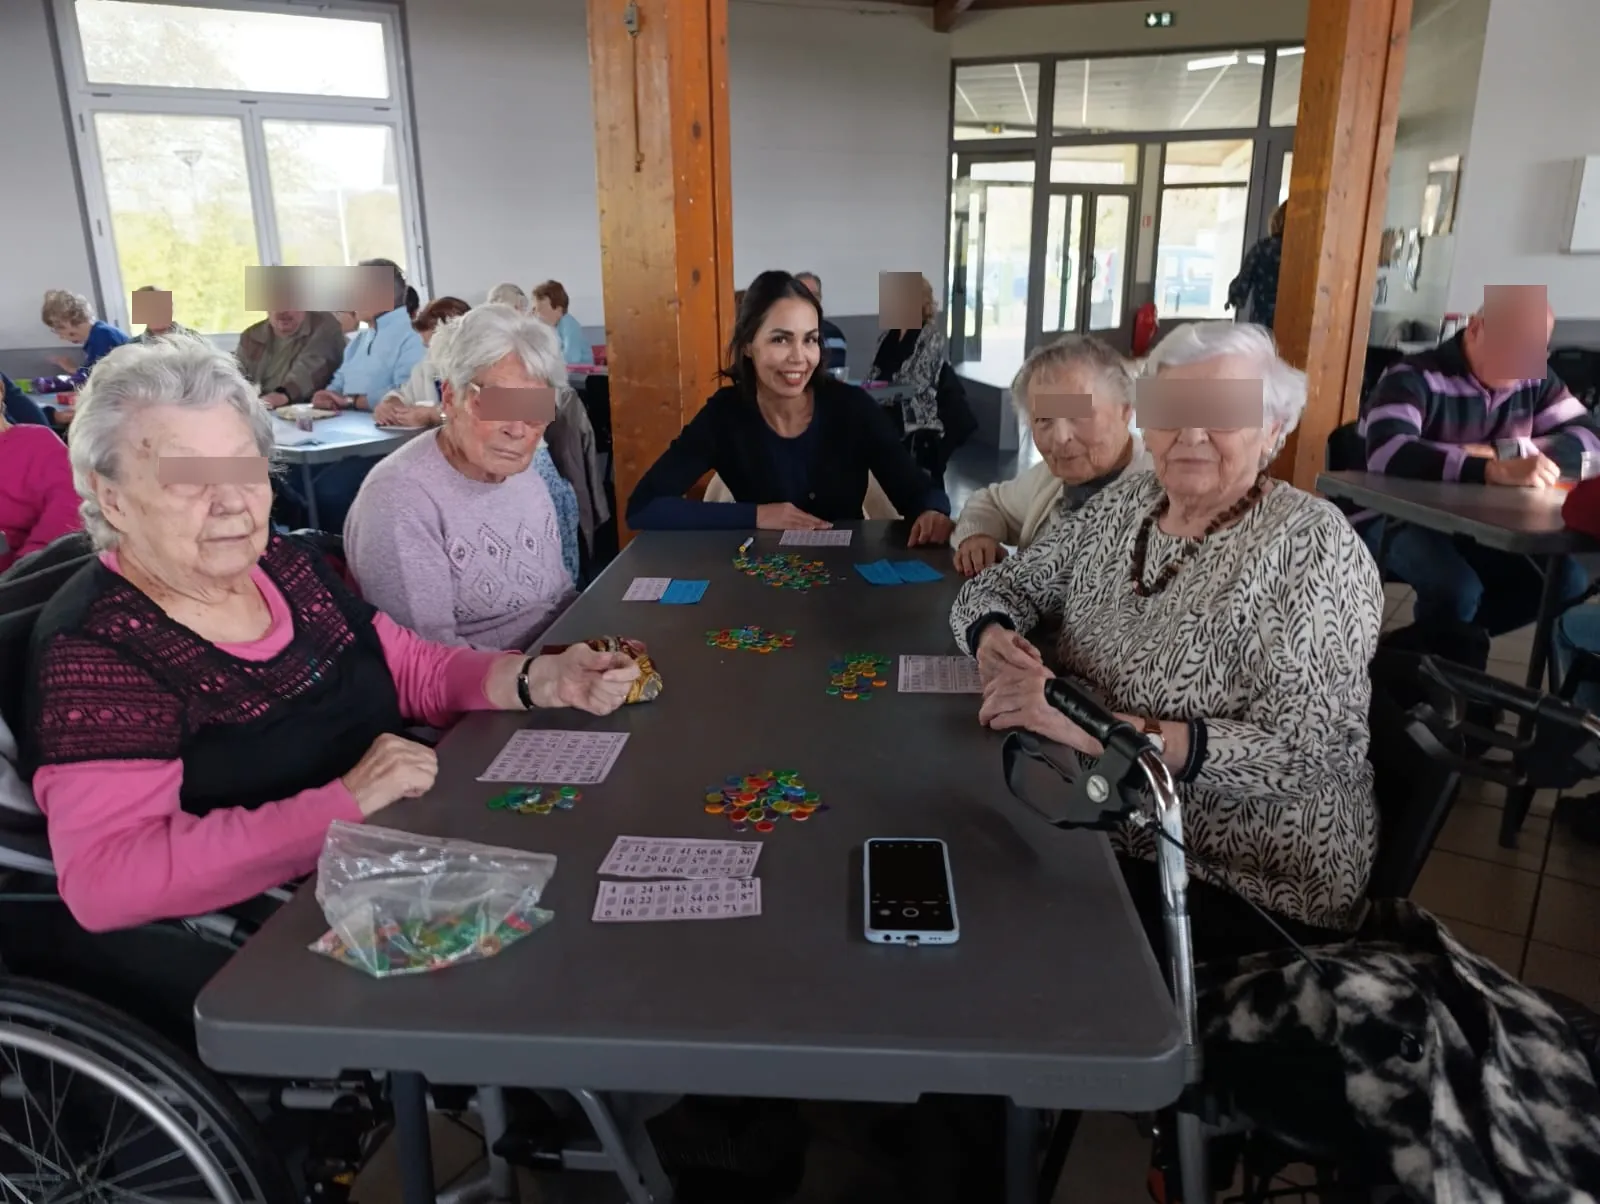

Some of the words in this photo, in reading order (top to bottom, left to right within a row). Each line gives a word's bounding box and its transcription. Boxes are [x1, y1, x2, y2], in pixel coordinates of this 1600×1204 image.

[624, 864, 636, 872] 14
[610, 885, 616, 894] 4
[641, 885, 653, 893] 24
[639, 896, 652, 904] 22
